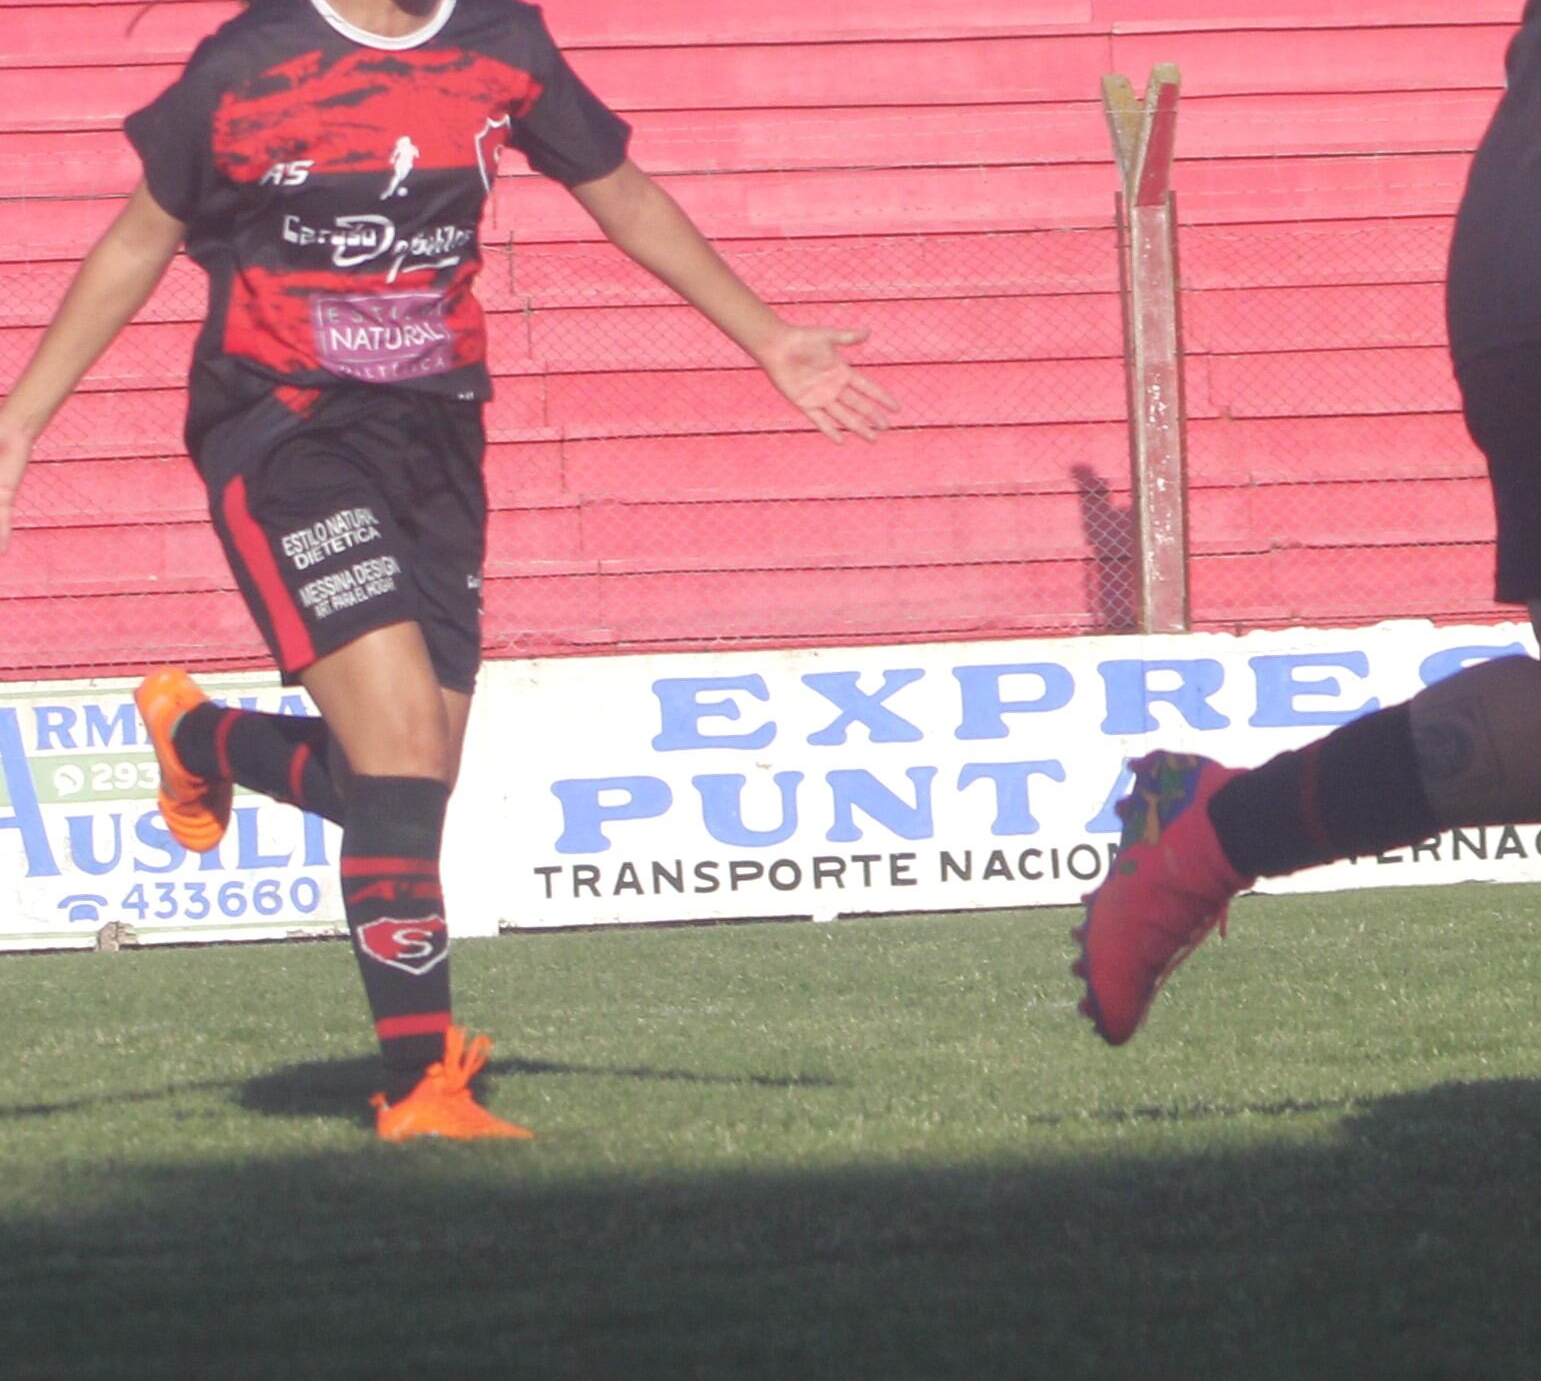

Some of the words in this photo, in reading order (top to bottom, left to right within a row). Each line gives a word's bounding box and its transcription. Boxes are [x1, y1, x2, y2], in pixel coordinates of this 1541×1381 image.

[260, 160, 315, 186] AS
[329, 322, 446, 351] NATURAL
[281, 521, 327, 557] ESTILO
[293, 525, 382, 570] DIETETICA
[534, 851, 918, 899] TRANSPORTE
[121, 876, 321, 920] 433660
